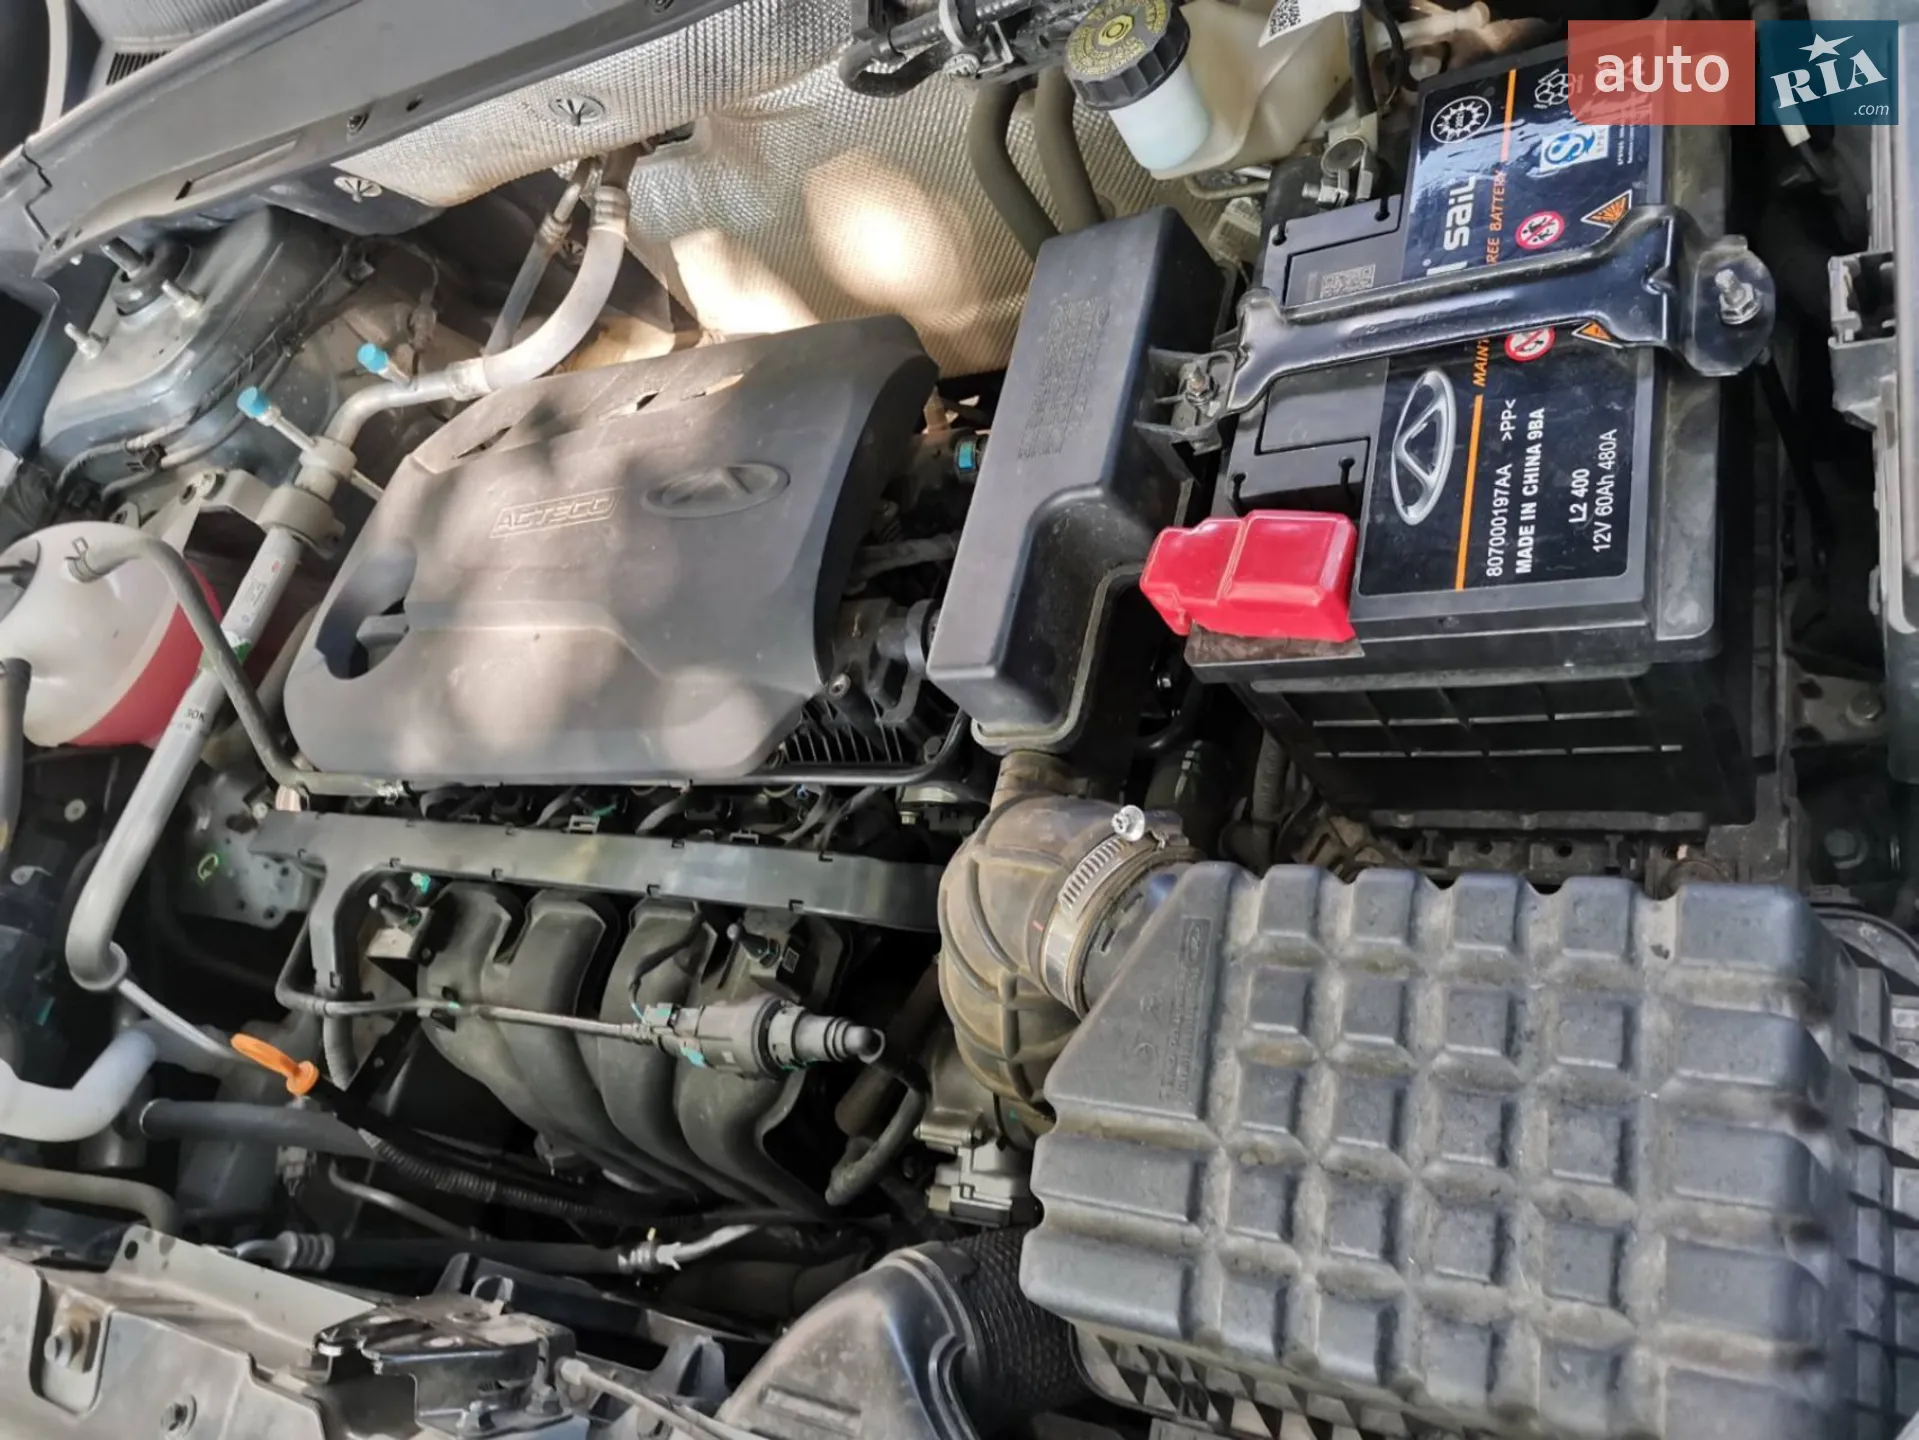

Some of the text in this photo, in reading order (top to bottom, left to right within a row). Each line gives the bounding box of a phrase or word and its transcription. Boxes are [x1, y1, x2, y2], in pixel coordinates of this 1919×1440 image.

[1489, 169, 1508, 232] BATTERY
[1486, 236, 1501, 265] REE
[1486, 463, 1513, 577] 807000197AA
[1515, 407, 1545, 574] MADE IN CHINA 9BA
[1568, 468, 1591, 523] L2 400
[1592, 428, 1618, 553] 12V 60Ah 480A
